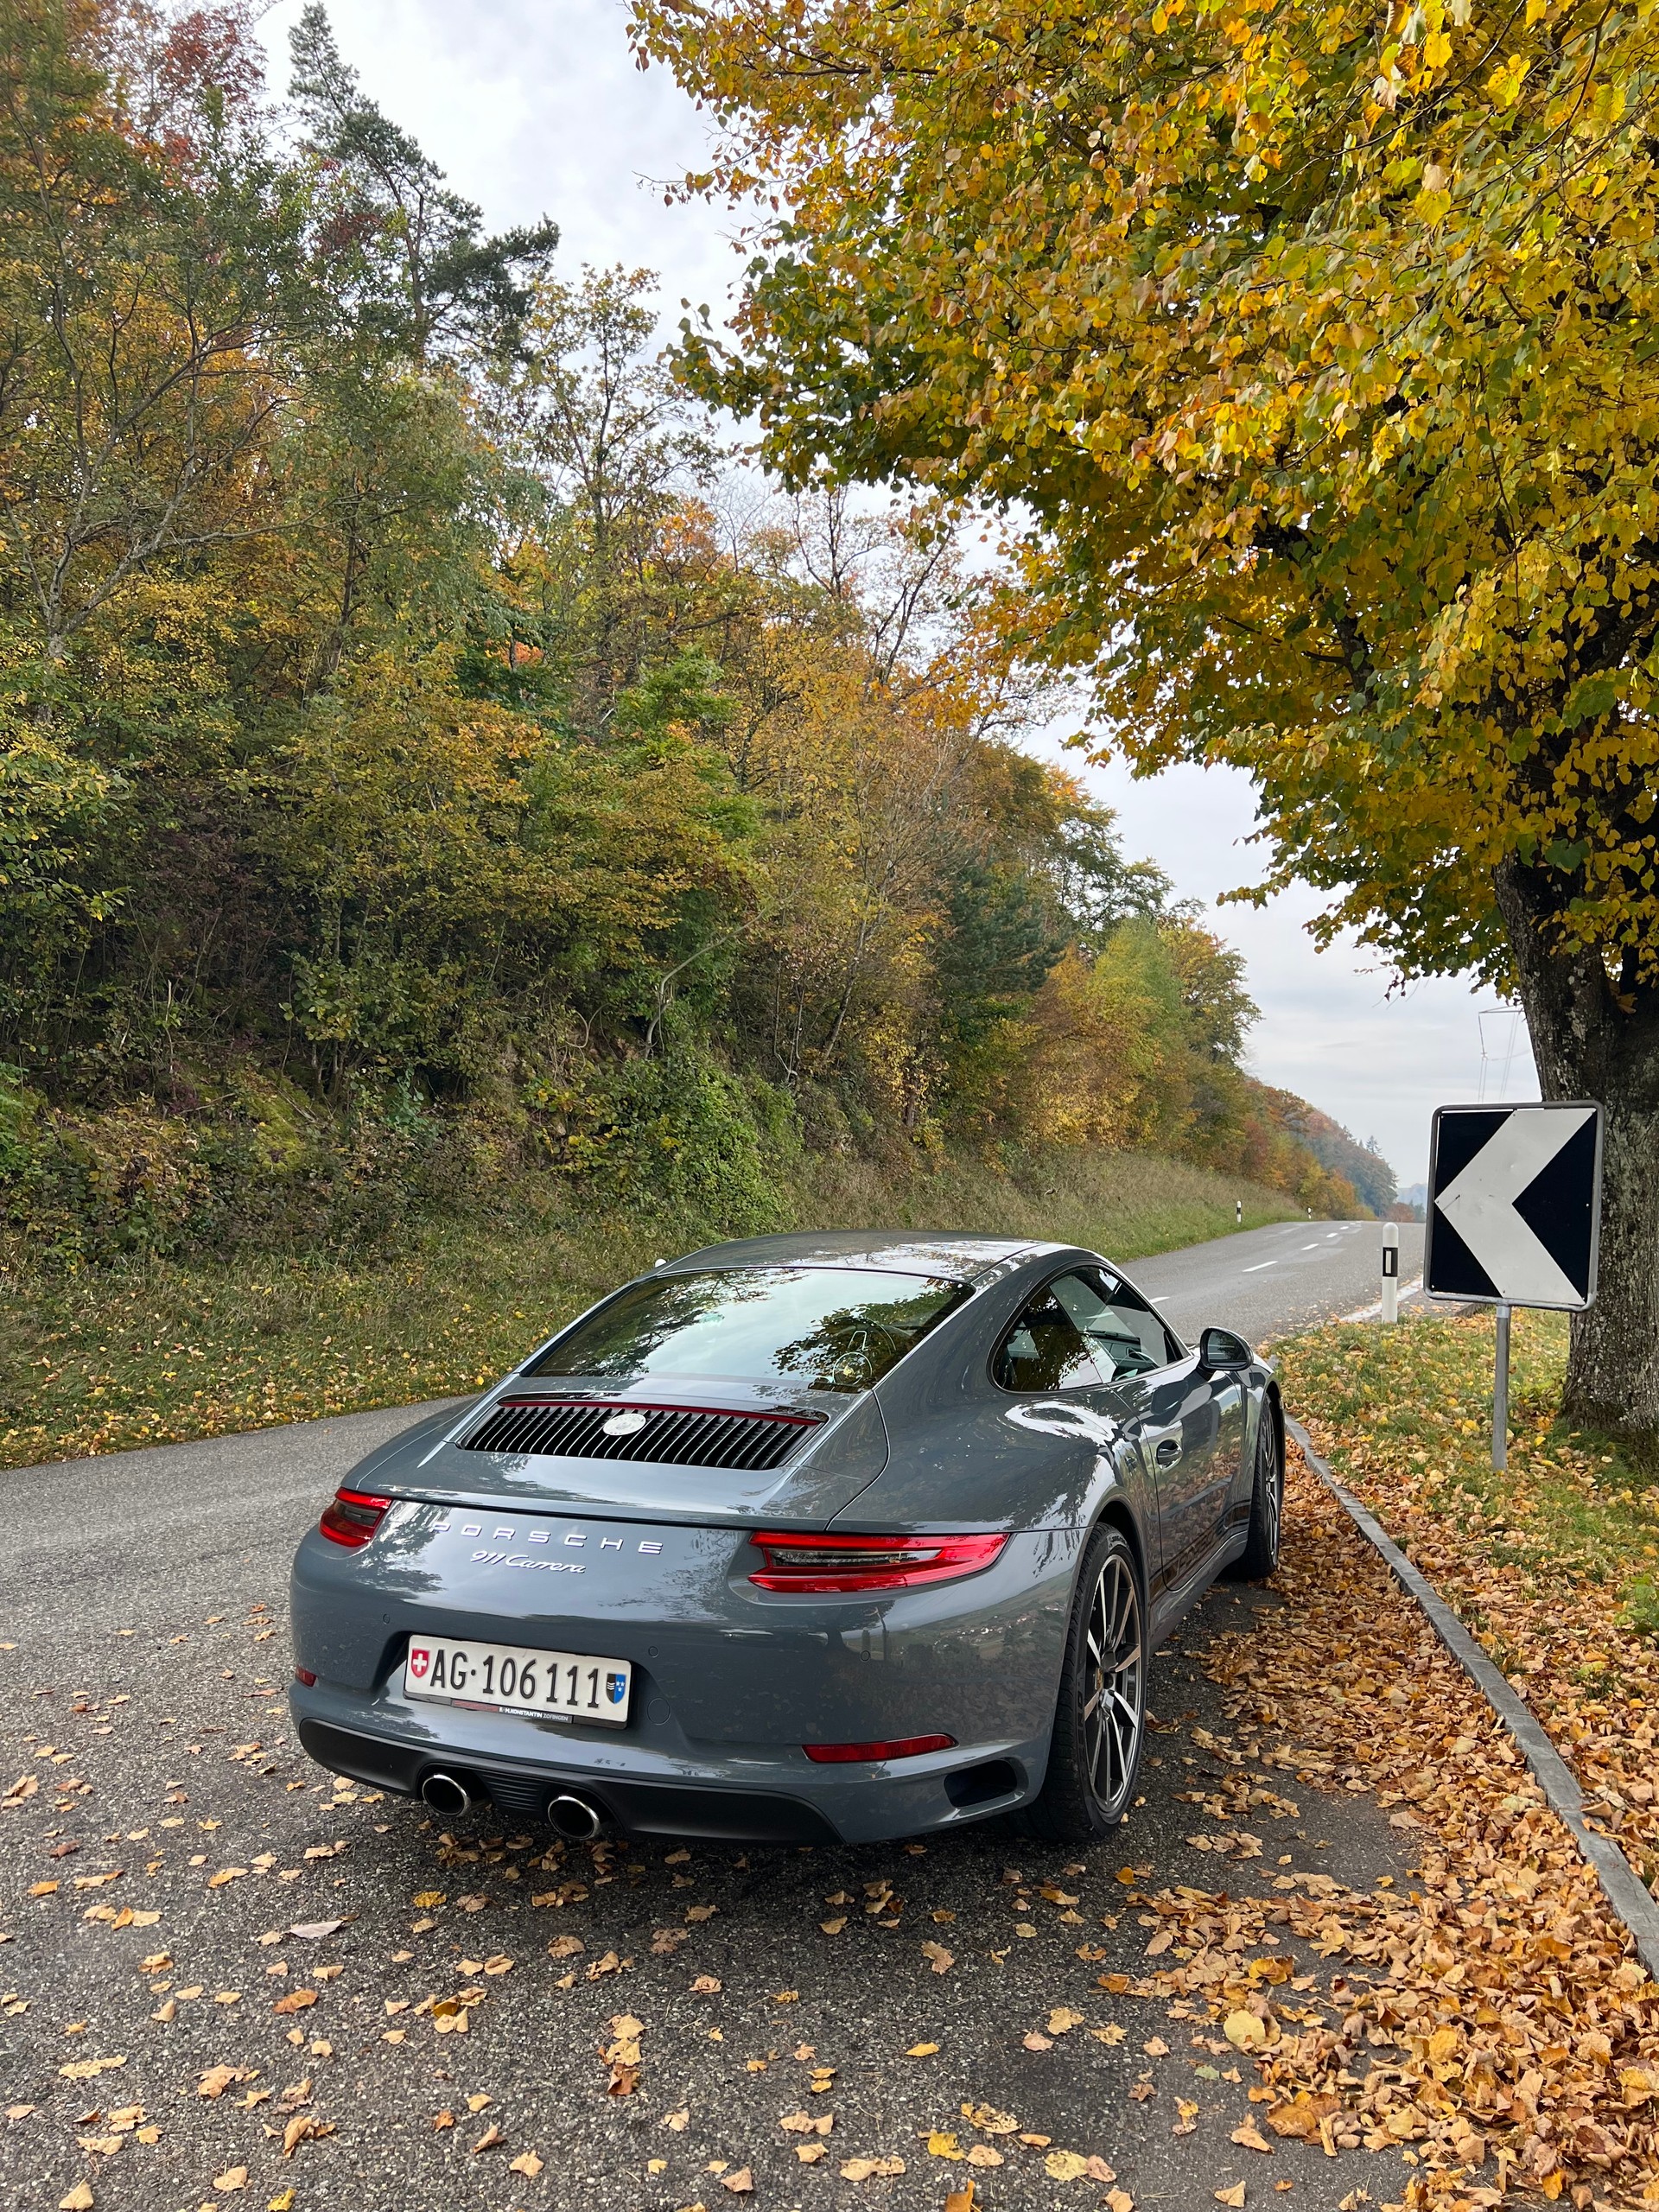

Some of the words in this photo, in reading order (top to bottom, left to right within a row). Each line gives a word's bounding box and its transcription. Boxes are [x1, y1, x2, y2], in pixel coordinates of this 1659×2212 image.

[431, 1521, 664, 1554] PORSCHE
[470, 1549, 506, 1564] 911
[505, 1554, 587, 1574] Carrera
[543, 1713, 569, 1721] ZOFINGEN
